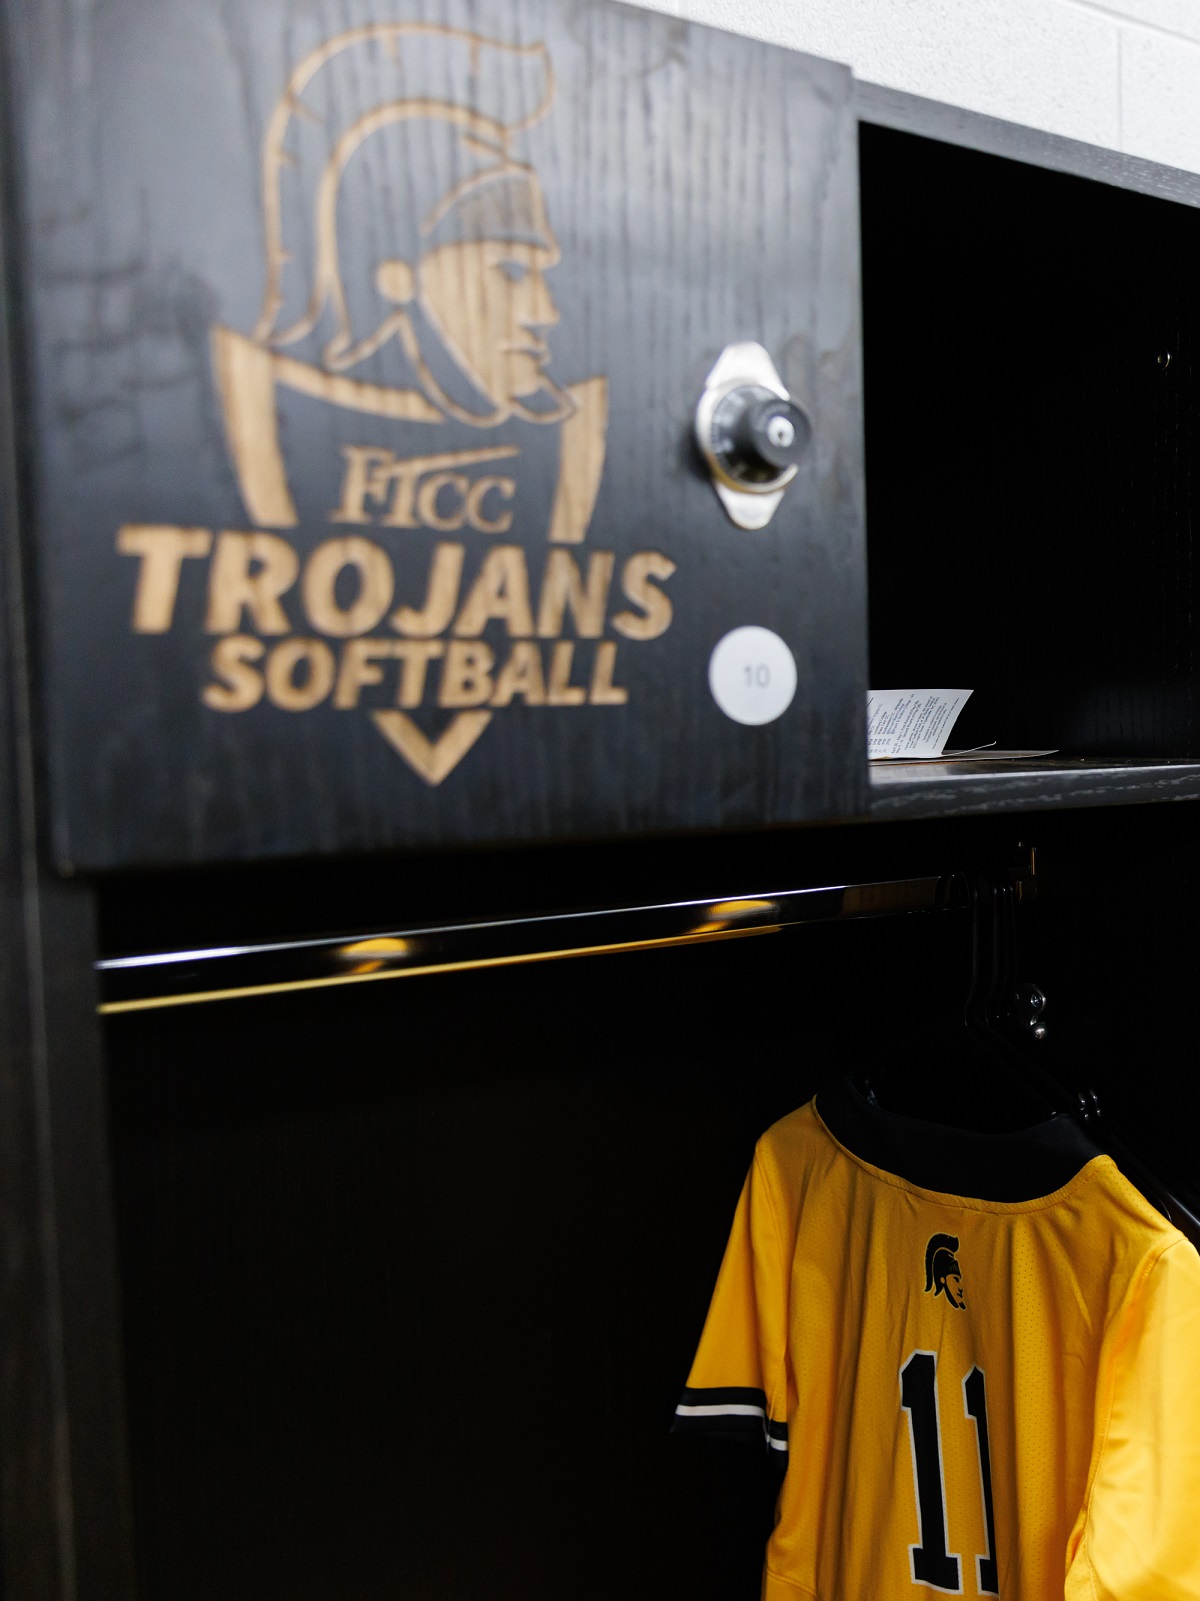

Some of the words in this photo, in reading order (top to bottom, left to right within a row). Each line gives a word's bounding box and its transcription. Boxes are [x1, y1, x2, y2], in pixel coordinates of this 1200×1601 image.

[117, 524, 676, 641] TROJANS
[202, 634, 629, 712] SOFTBALL
[743, 662, 772, 690] 10
[899, 1348, 1000, 1596] 11
